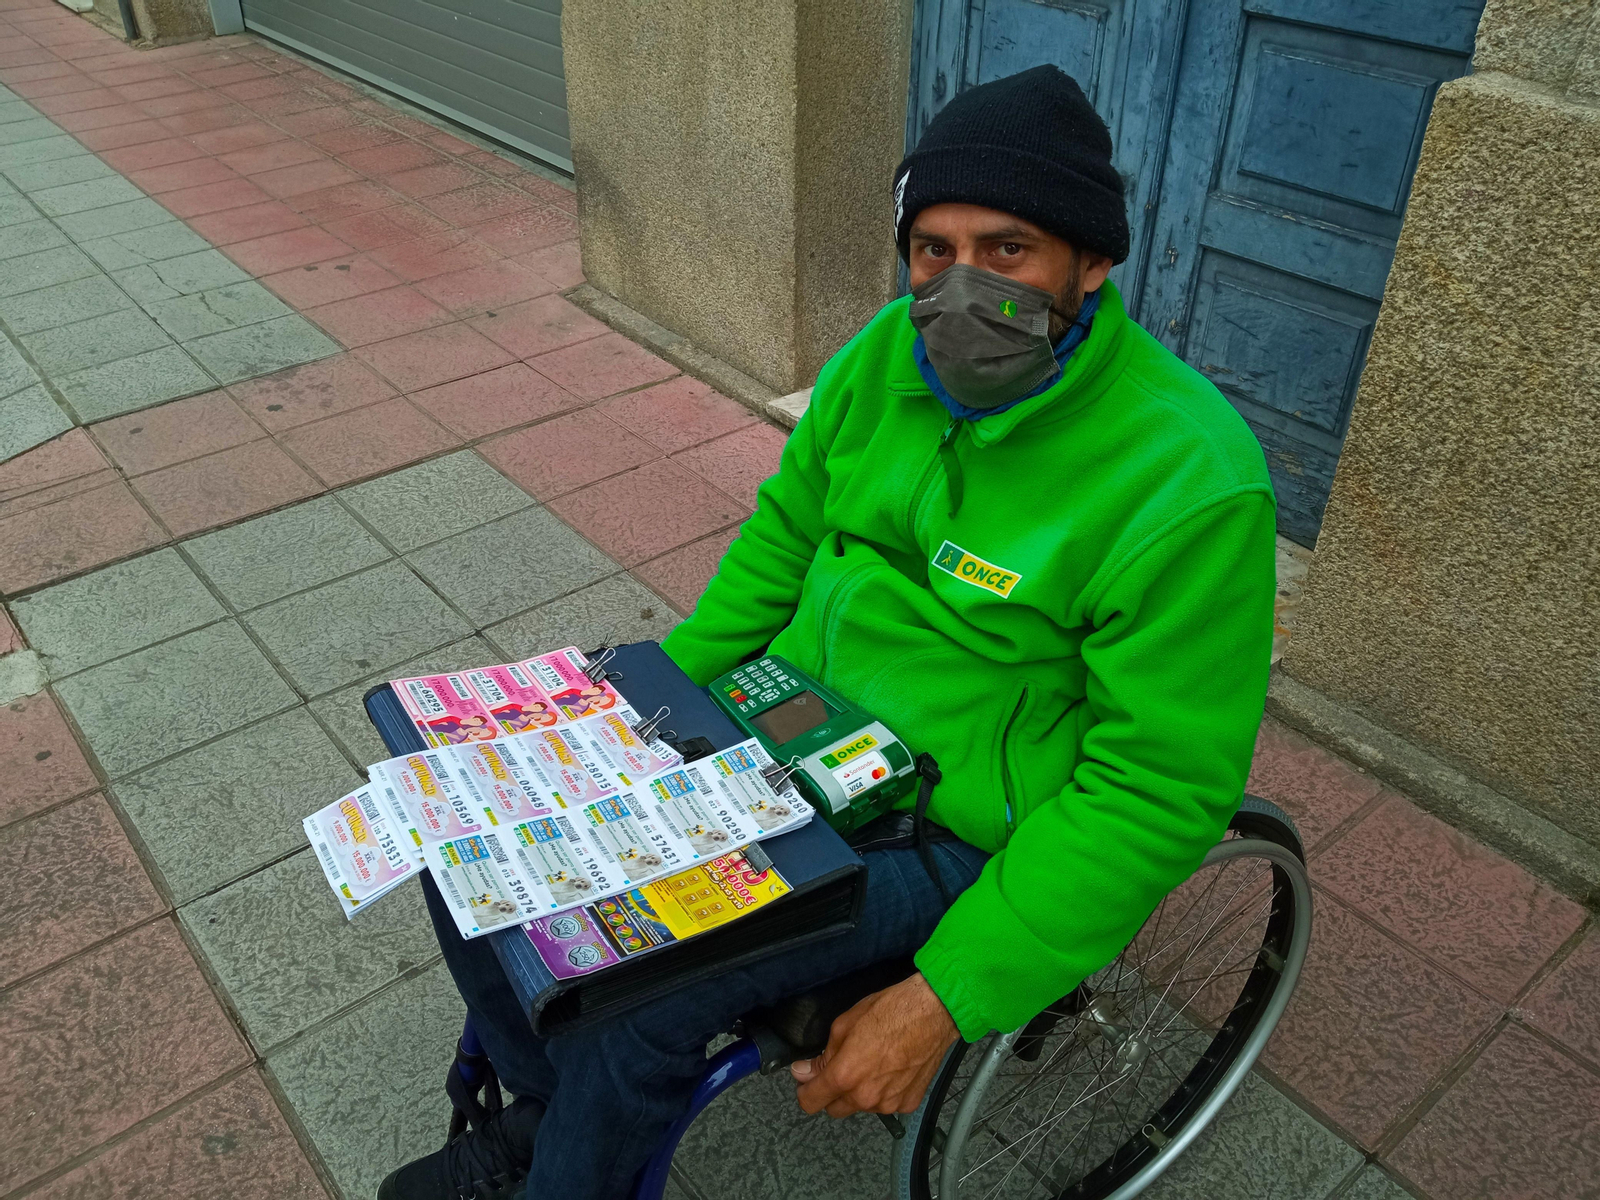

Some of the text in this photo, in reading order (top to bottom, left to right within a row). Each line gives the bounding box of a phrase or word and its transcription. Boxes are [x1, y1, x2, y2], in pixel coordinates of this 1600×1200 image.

[962, 561, 1013, 591] ONCE
[541, 666, 564, 686] 31704
[421, 688, 444, 712] 60295
[482, 679, 505, 700] 31704
[603, 713, 637, 746] CUPONAZO
[540, 730, 575, 765] CUPONAZO
[646, 740, 672, 759] 28015
[837, 737, 873, 758] ONCE
[475, 742, 510, 780] CUPONAZO
[719, 760, 732, 775] ONCE
[403, 755, 440, 795] CUPONAZO
[584, 761, 611, 789] 28015
[848, 781, 864, 792] VISA
[518, 779, 544, 808] 06048
[656, 784, 671, 799] ONCE
[782, 790, 808, 814] 0280
[337, 798, 371, 844] CUPONAZO
[432, 806, 442, 815] XXL
[447, 794, 475, 825] 10569
[591, 809, 605, 823] ONCE
[522, 828, 535, 844] ONCE
[715, 809, 747, 840] 90280
[363, 852, 373, 863] XXL
[377, 833, 404, 867] 75831
[447, 848, 460, 865] ONCE
[650, 834, 681, 865] 57431
[581, 858, 612, 890] 19692
[500, 868, 538, 914] 015 39874
[573, 913, 589, 932] BONUS
[591, 941, 609, 959] BONUS
